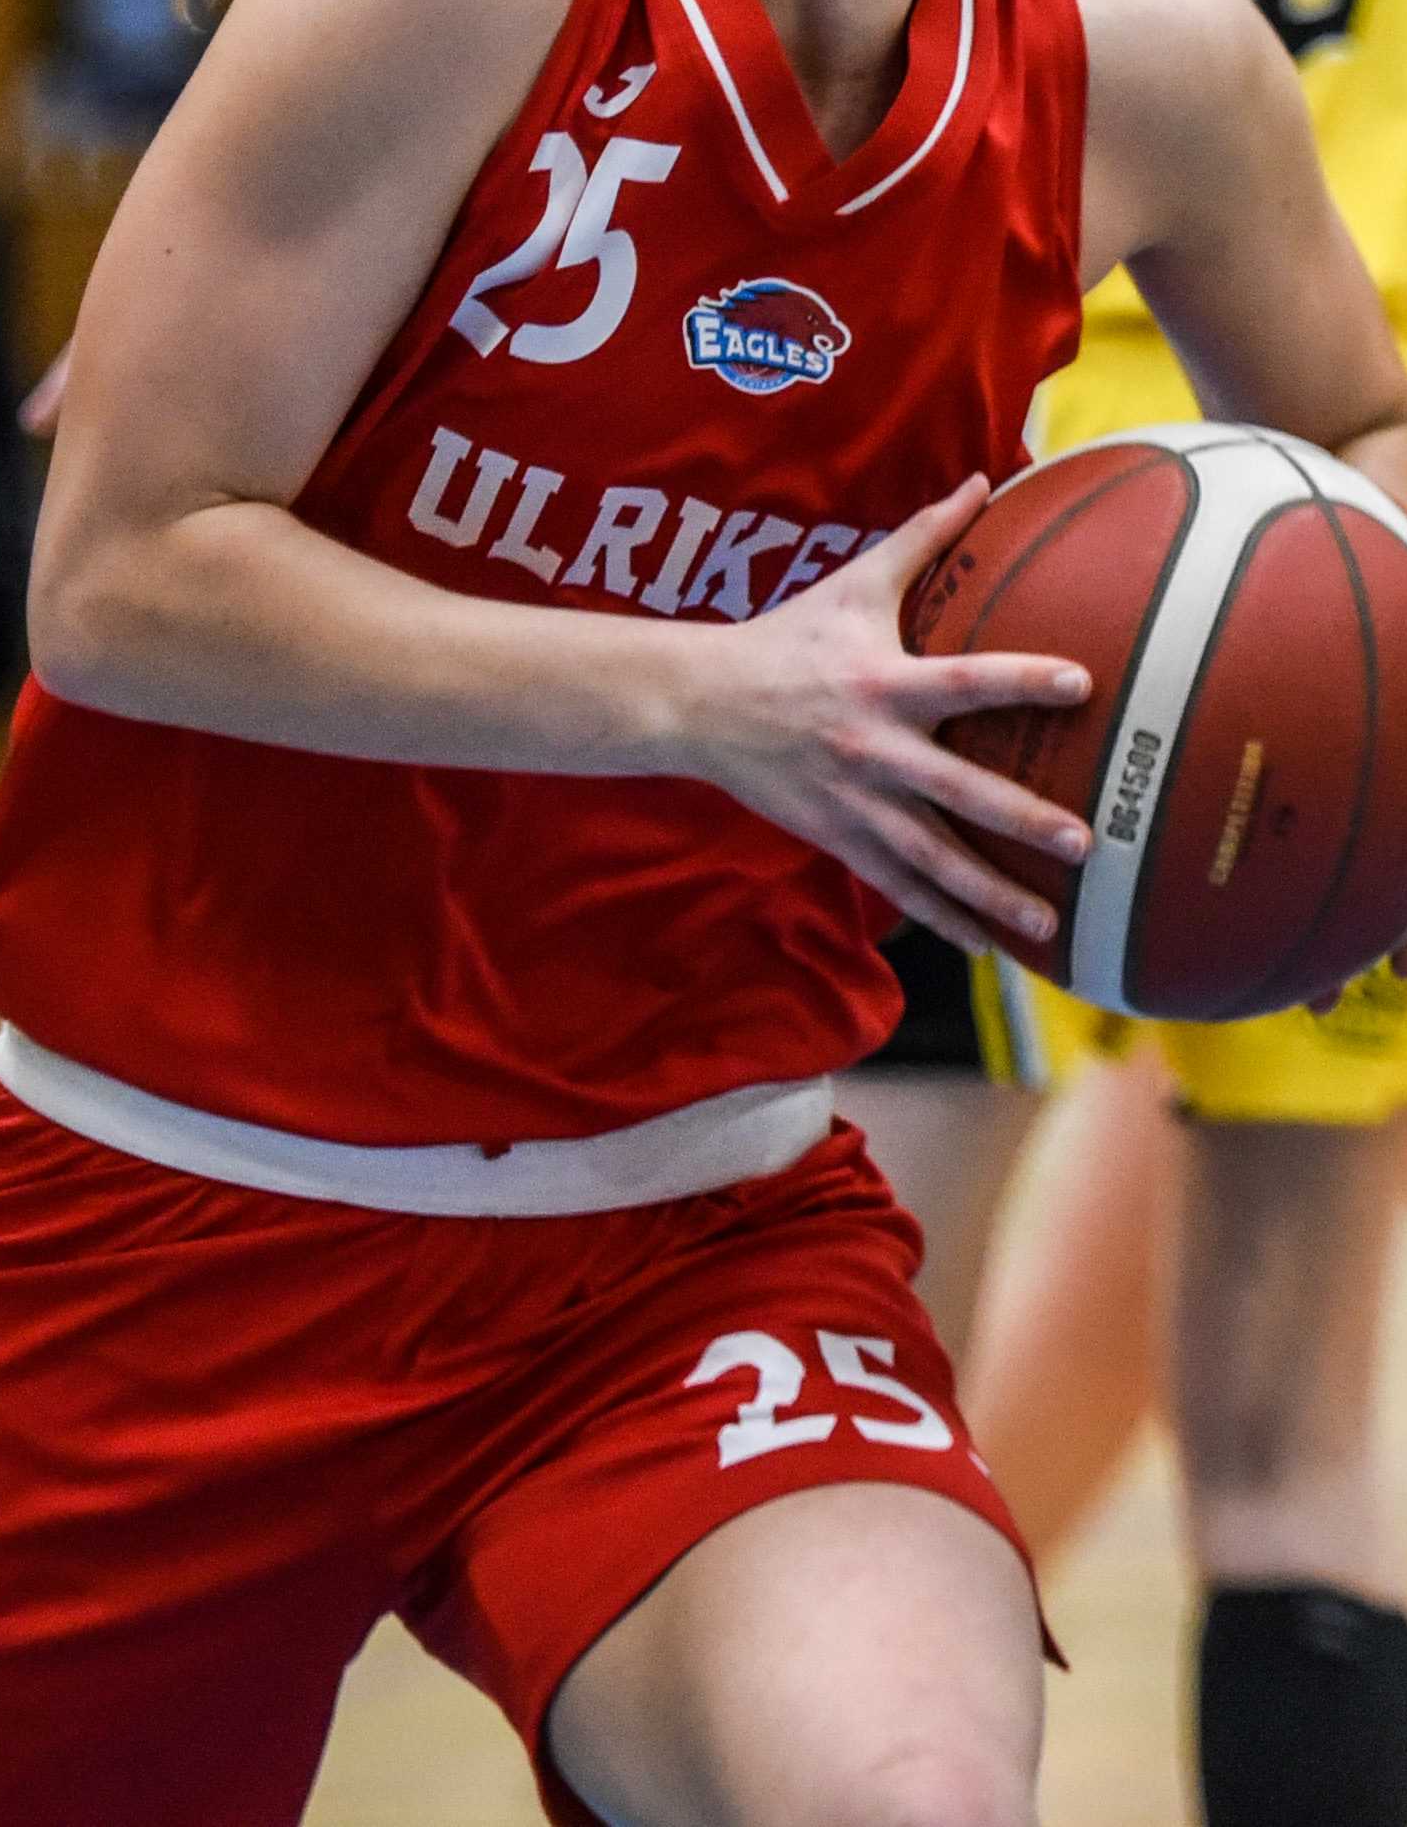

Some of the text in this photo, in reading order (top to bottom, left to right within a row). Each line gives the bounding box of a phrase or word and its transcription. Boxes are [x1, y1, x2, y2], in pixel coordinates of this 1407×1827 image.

[449, 130, 682, 365] 25
[695, 315, 825, 373] EAGLES
[407, 425, 896, 623] ULRIKE
[682, 1329, 954, 1470] 25
